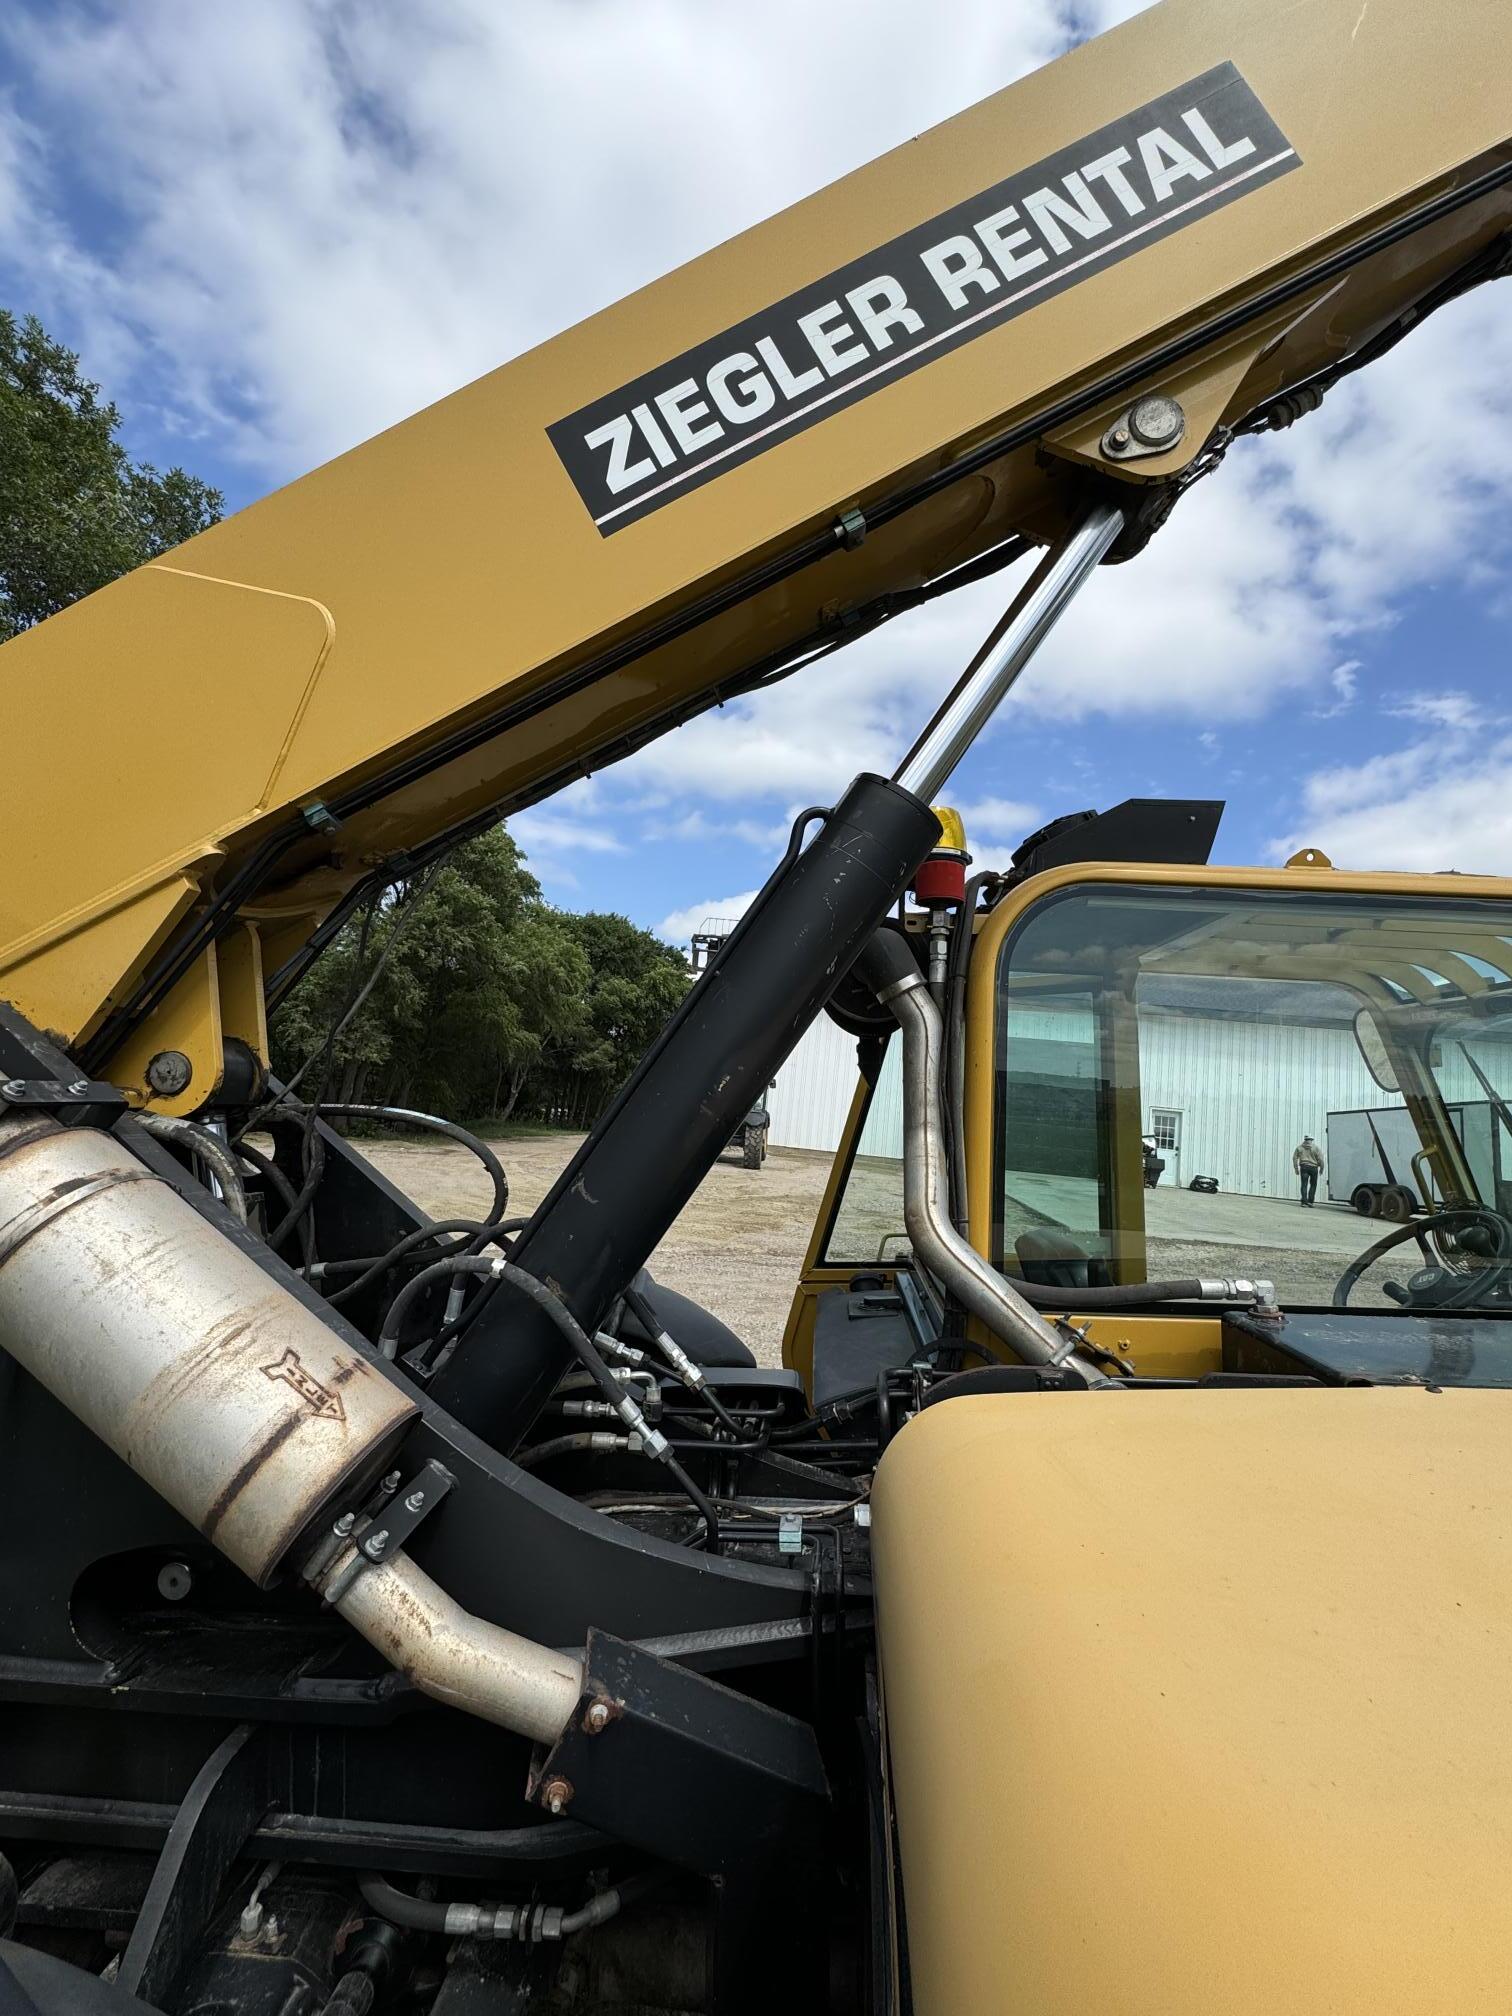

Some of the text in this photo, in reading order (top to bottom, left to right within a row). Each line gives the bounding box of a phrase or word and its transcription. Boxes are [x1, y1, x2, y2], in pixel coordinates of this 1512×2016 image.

[583, 106, 1257, 495] ZIEGLER RENTAL
[286, 1366, 338, 1414] INLET
